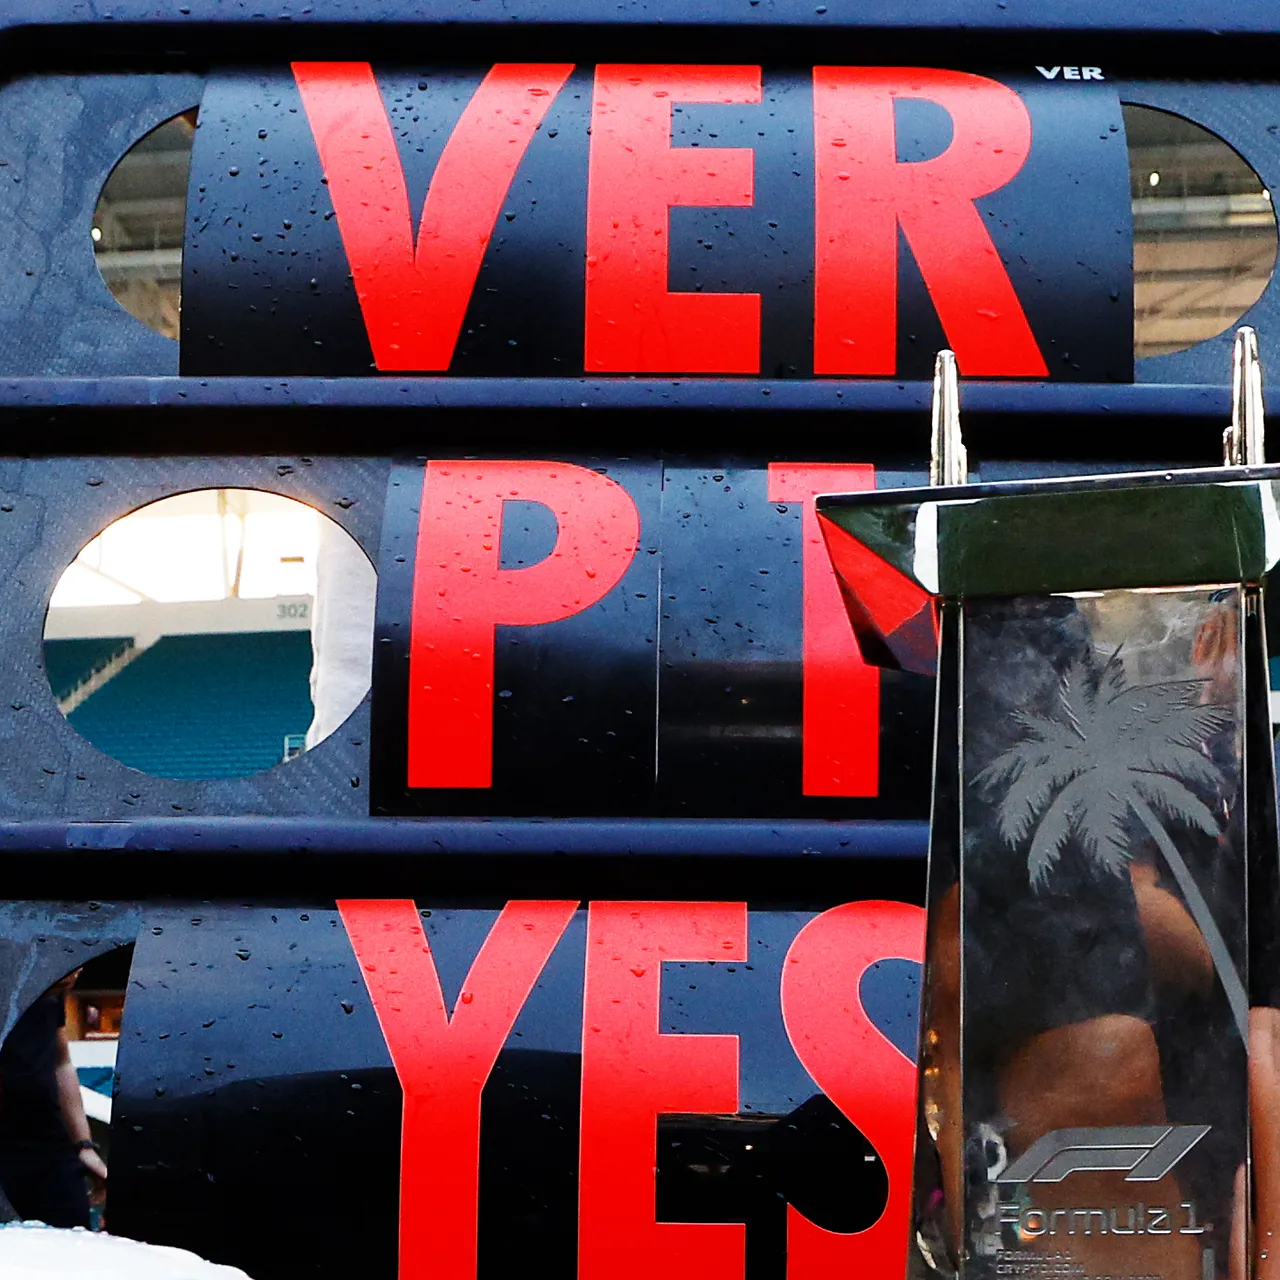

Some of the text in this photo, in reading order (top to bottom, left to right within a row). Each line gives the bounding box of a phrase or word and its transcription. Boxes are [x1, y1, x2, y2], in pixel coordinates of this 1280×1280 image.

[1035, 65, 1105, 80] VER
[291, 61, 1050, 377] VER
[277, 603, 309, 618] 302
